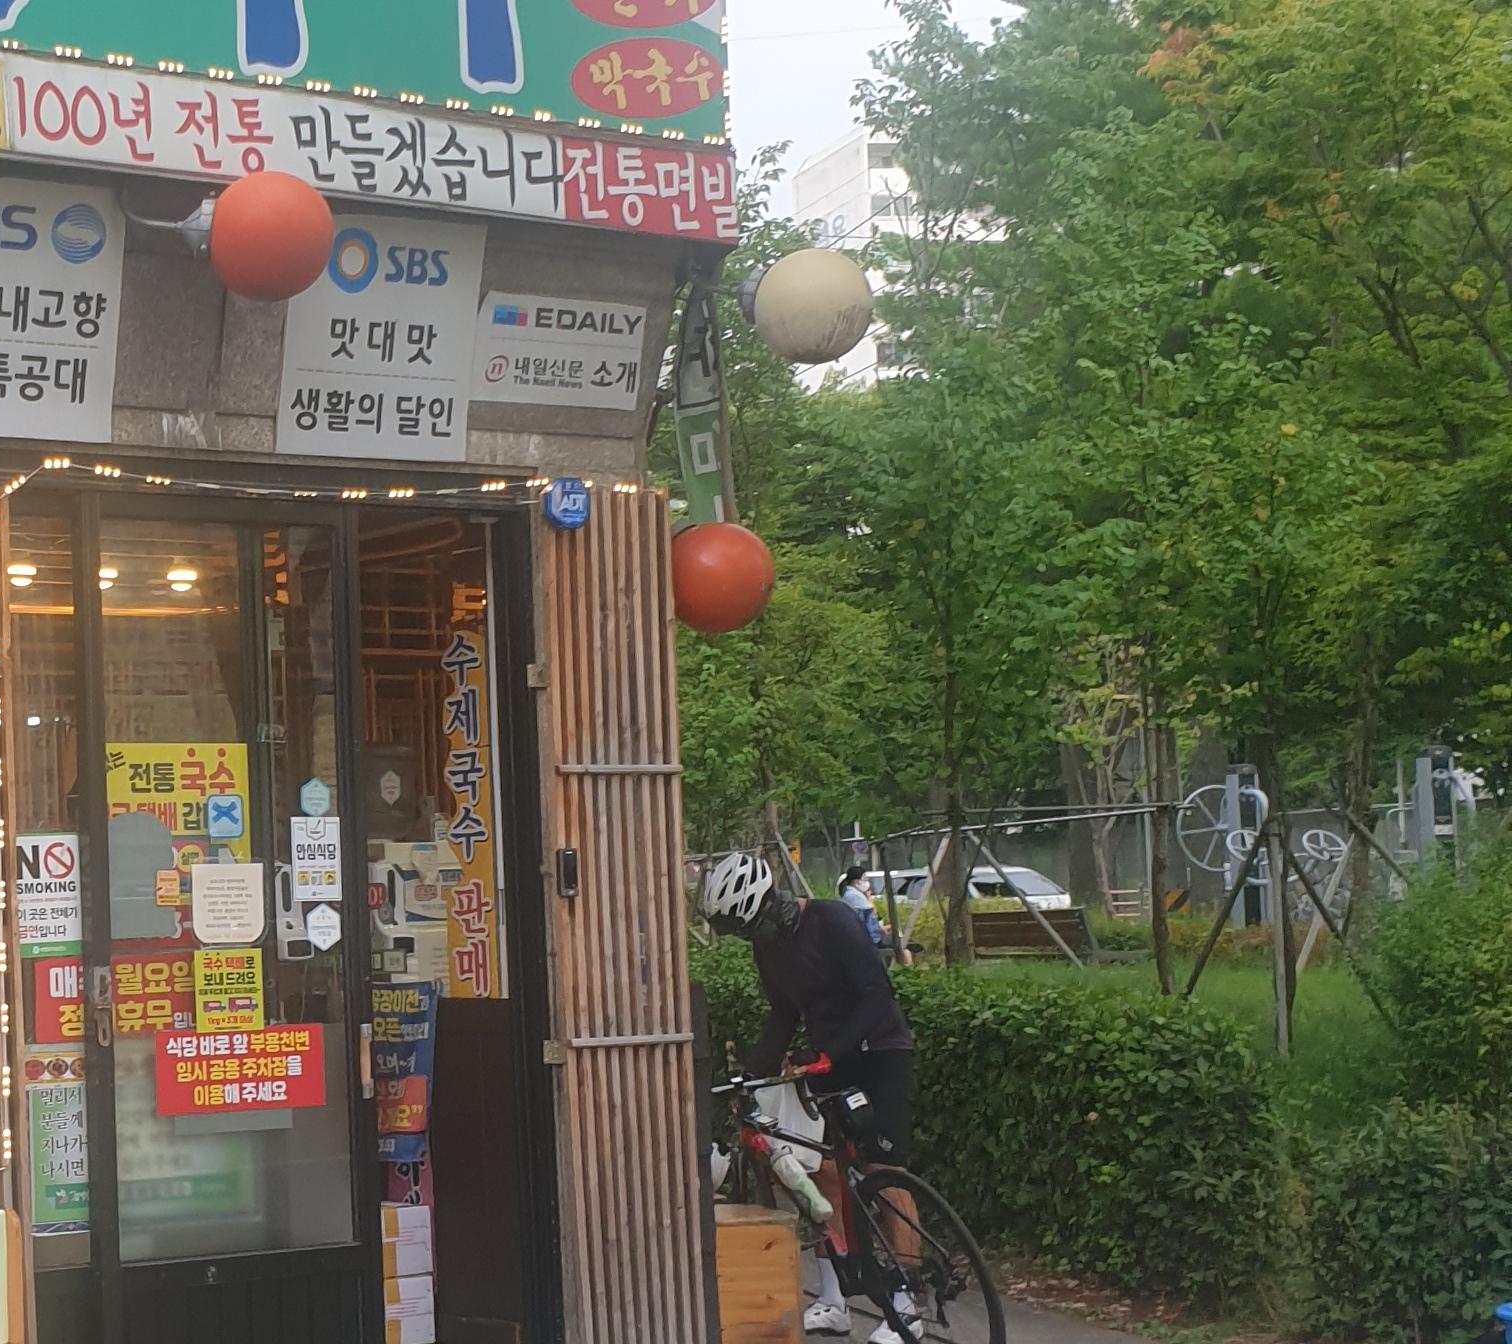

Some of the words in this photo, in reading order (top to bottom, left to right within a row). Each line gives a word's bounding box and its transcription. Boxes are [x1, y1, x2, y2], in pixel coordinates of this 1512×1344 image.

[589, 49, 714, 110] 막국수
[12, 75, 156, 163] 100년
[177, 90, 275, 176] 전통
[289, 103, 565, 213] 만들겠습니다
[385, 245, 449, 287] SBS
[535, 307, 642, 336] EDAILY
[515, 357, 584, 378] 내일신문
[590, 361, 638, 394] 소개
[290, 388, 385, 434] 생활의
[395, 396, 454, 438] 달인
[129, 762, 175, 794] 전통
[180, 748, 236, 797] 국수
[296, 843, 337, 861] 안심식당
[16, 880, 76, 895] SMOKING
[49, 965, 85, 998] 매
[166, 1037, 198, 1058] 식당
[200, 1035, 231, 1056] 바로
[232, 1033, 249, 1054] 앞
[250, 1030, 311, 1053] 부용천변
[176, 1061, 207, 1083] 임시
[209, 1059, 240, 1080] 공용
[242, 1055, 303, 1079] 주차장을
[194, 1084, 240, 1106] 이용해
[241, 1081, 288, 1103] 주세요
